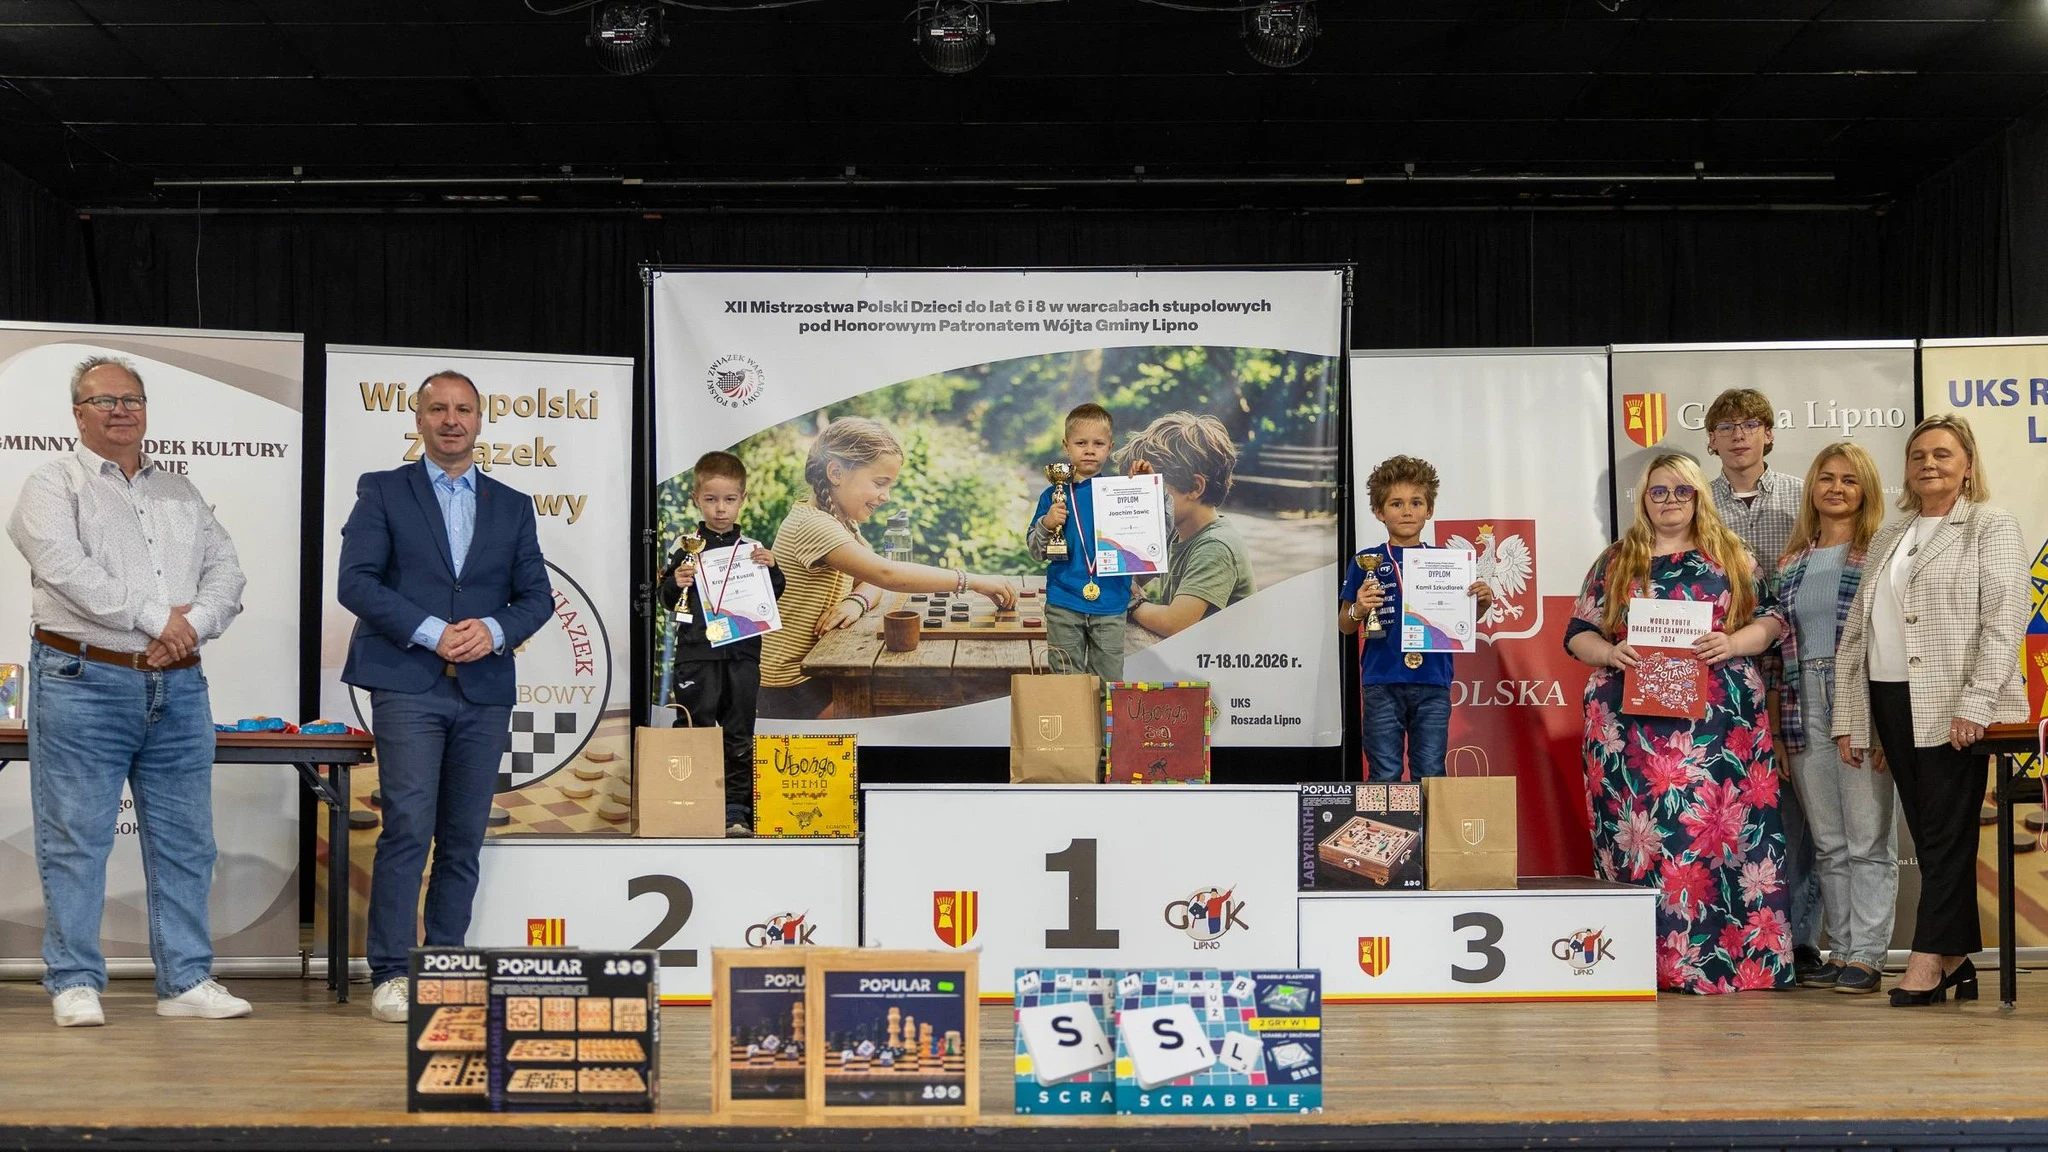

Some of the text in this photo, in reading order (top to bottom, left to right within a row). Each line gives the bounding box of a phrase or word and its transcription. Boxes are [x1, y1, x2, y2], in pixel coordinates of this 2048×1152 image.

[724, 298, 1272, 315] XII Mistrzostwa Polski Dzieci do lat 6 i 8 w warcabach stupolowych
[799, 317, 1199, 336] pod Honorowym Patronatem Wójta Gminy Lipno
[1949, 378, 2020, 408] UKS
[359, 381, 600, 423] Wiepolski
[1804, 400, 1907, 437] Lipno
[191, 440, 289, 459] KULTURY
[402, 432, 558, 472] Zązek
[1117, 495, 1140, 504] DYPLOM
[1428, 570, 1451, 578] DYPLOM
[1649, 617, 1691, 627] WORLD YOUTH
[1660, 635, 1676, 643] 2024
[1196, 653, 1303, 670] 17-18.10.2026 r.
[1655, 664, 1693, 681] POLAND
[1450, 679, 1568, 707] OLSKA
[1127, 695, 1189, 725] Ubongo
[1230, 697, 1251, 709] UKS
[1230, 714, 1302, 728] Roszada Lipno
[774, 747, 836, 778] Ubongo
[781, 780, 829, 789] SHIMO
[1302, 785, 1352, 794] POPULAR
[1303, 806, 1315, 888] LABYRINTH
[1045, 838, 1120, 949] 1
[628, 874, 698, 968] 2
[1193, 941, 1221, 950] LIPNO
[1451, 911, 1507, 984] 3
[424, 954, 488, 971] POPUL
[497, 959, 583, 975] POPULAR
[764, 973, 805, 988] POPU
[859, 978, 931, 993] POPULAR
[1051, 1016, 1083, 1047] S
[1152, 1018, 1184, 1050] S
[1039, 1091, 1113, 1104] SCRA
[1140, 1093, 1300, 1108] SCRABBLE
